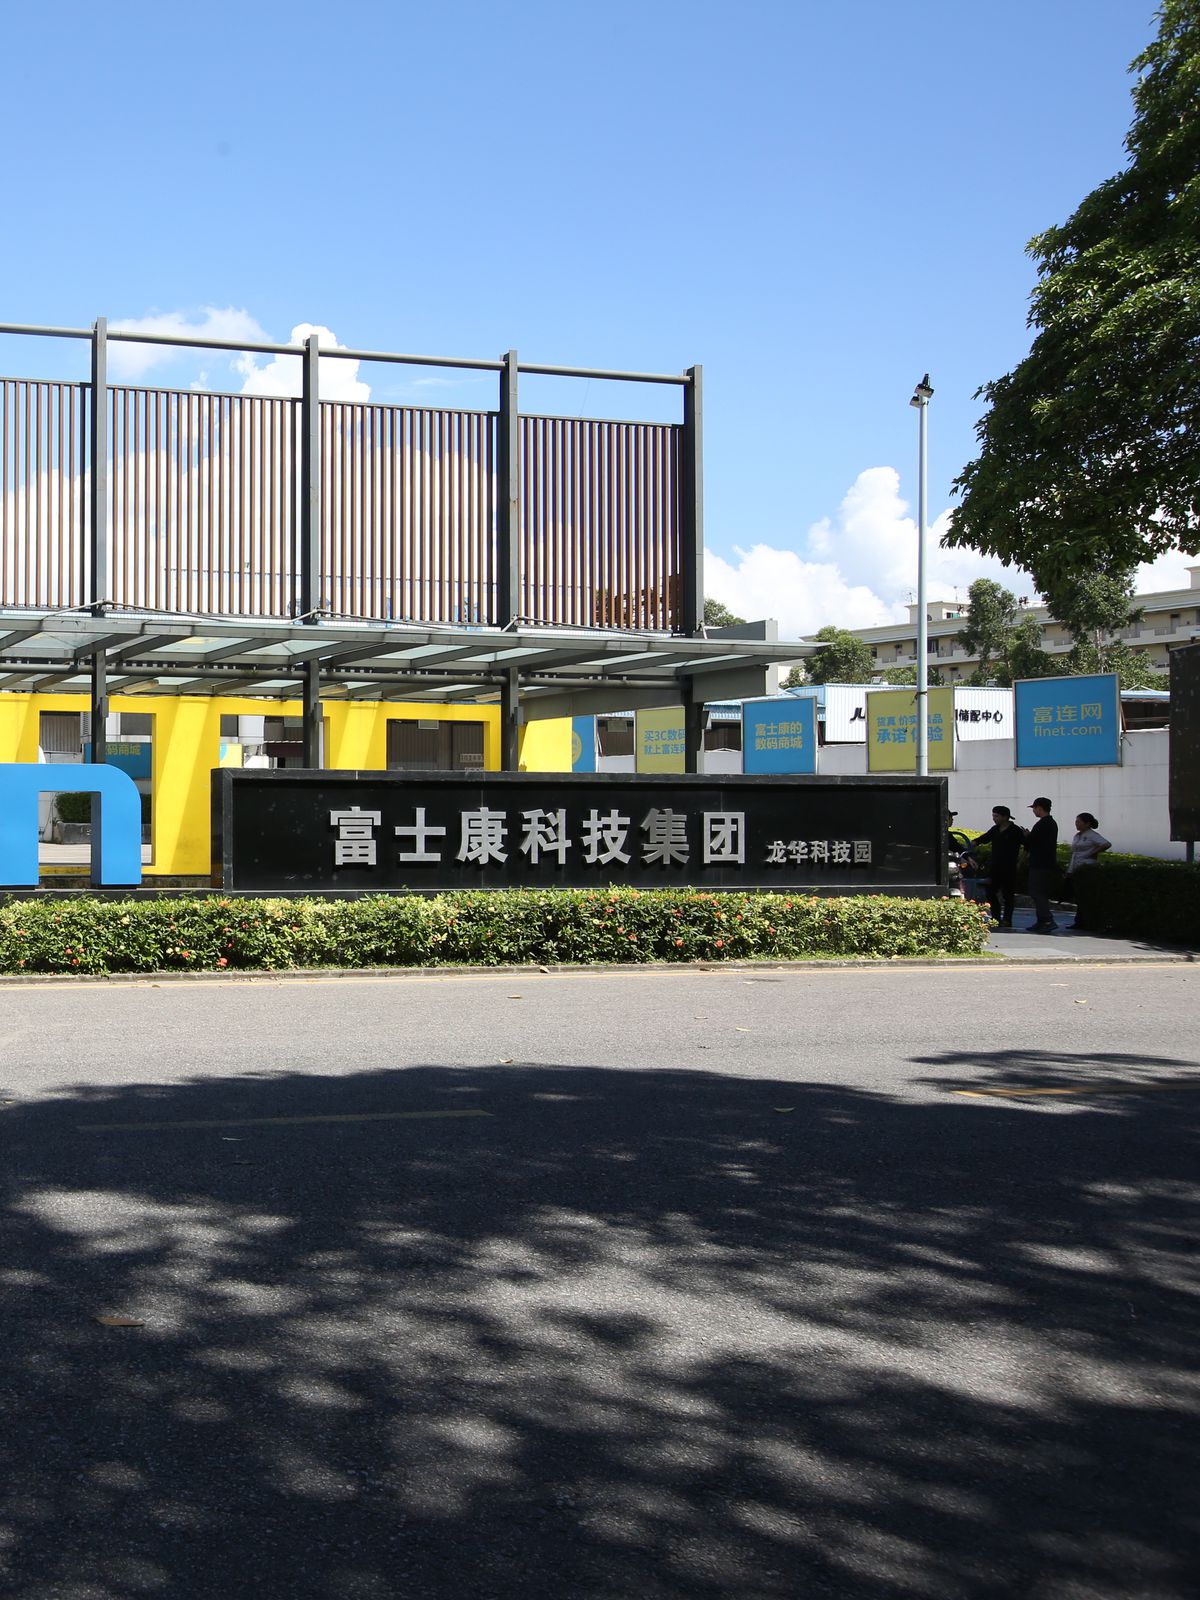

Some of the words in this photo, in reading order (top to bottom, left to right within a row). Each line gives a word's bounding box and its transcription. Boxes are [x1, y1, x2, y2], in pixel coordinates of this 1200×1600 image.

[1033, 703, 1102, 724] 富连网
[755, 722, 802, 736] 富士康的
[1034, 725, 1102, 737] flnet.com
[105, 743, 141, 755] 码商城
[755, 736, 803, 750] 数码商城
[330, 806, 746, 866] 富士康科技集团
[765, 840, 872, 864] 龙华科技园
